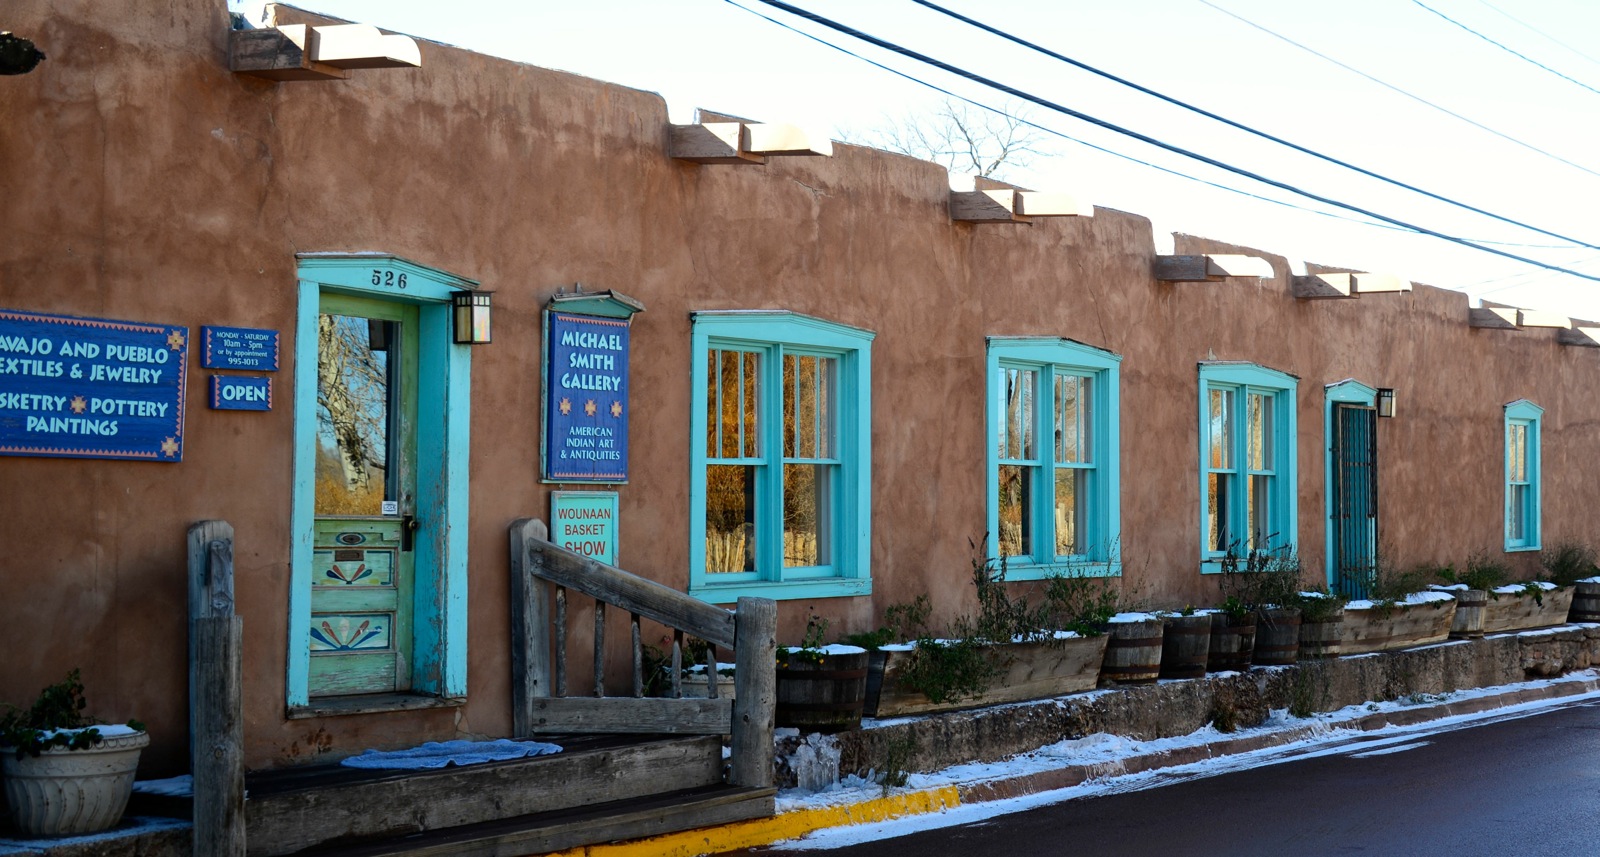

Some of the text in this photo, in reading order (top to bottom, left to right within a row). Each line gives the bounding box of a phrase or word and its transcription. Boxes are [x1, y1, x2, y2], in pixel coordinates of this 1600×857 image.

[371, 269, 407, 289] 526
[223, 339, 240, 348] 10am
[248, 341, 262, 350] 5pm
[244, 333, 269, 341] SATURDAY
[561, 330, 623, 351] MICHAEL
[59, 340, 100, 359] AND
[106, 344, 169, 364] PUEBLO
[569, 352, 614, 371] SMITH
[69, 363, 83, 379] &
[89, 364, 162, 384] JEWELRY
[561, 372, 621, 392] GALLERY
[222, 384, 266, 402] OPEN
[0, 392, 169, 418] SKETRY POTTERY
[26, 415, 118, 436] PAINTINGS
[569, 426, 613, 437] AMERICAN
[566, 437, 615, 449] INDIAN ART
[560, 449, 620, 461] & ANTIQUITIES
[558, 508, 611, 520] WOUNAAN
[564, 524, 605, 536] BASKET
[564, 541, 606, 556] SHOW
